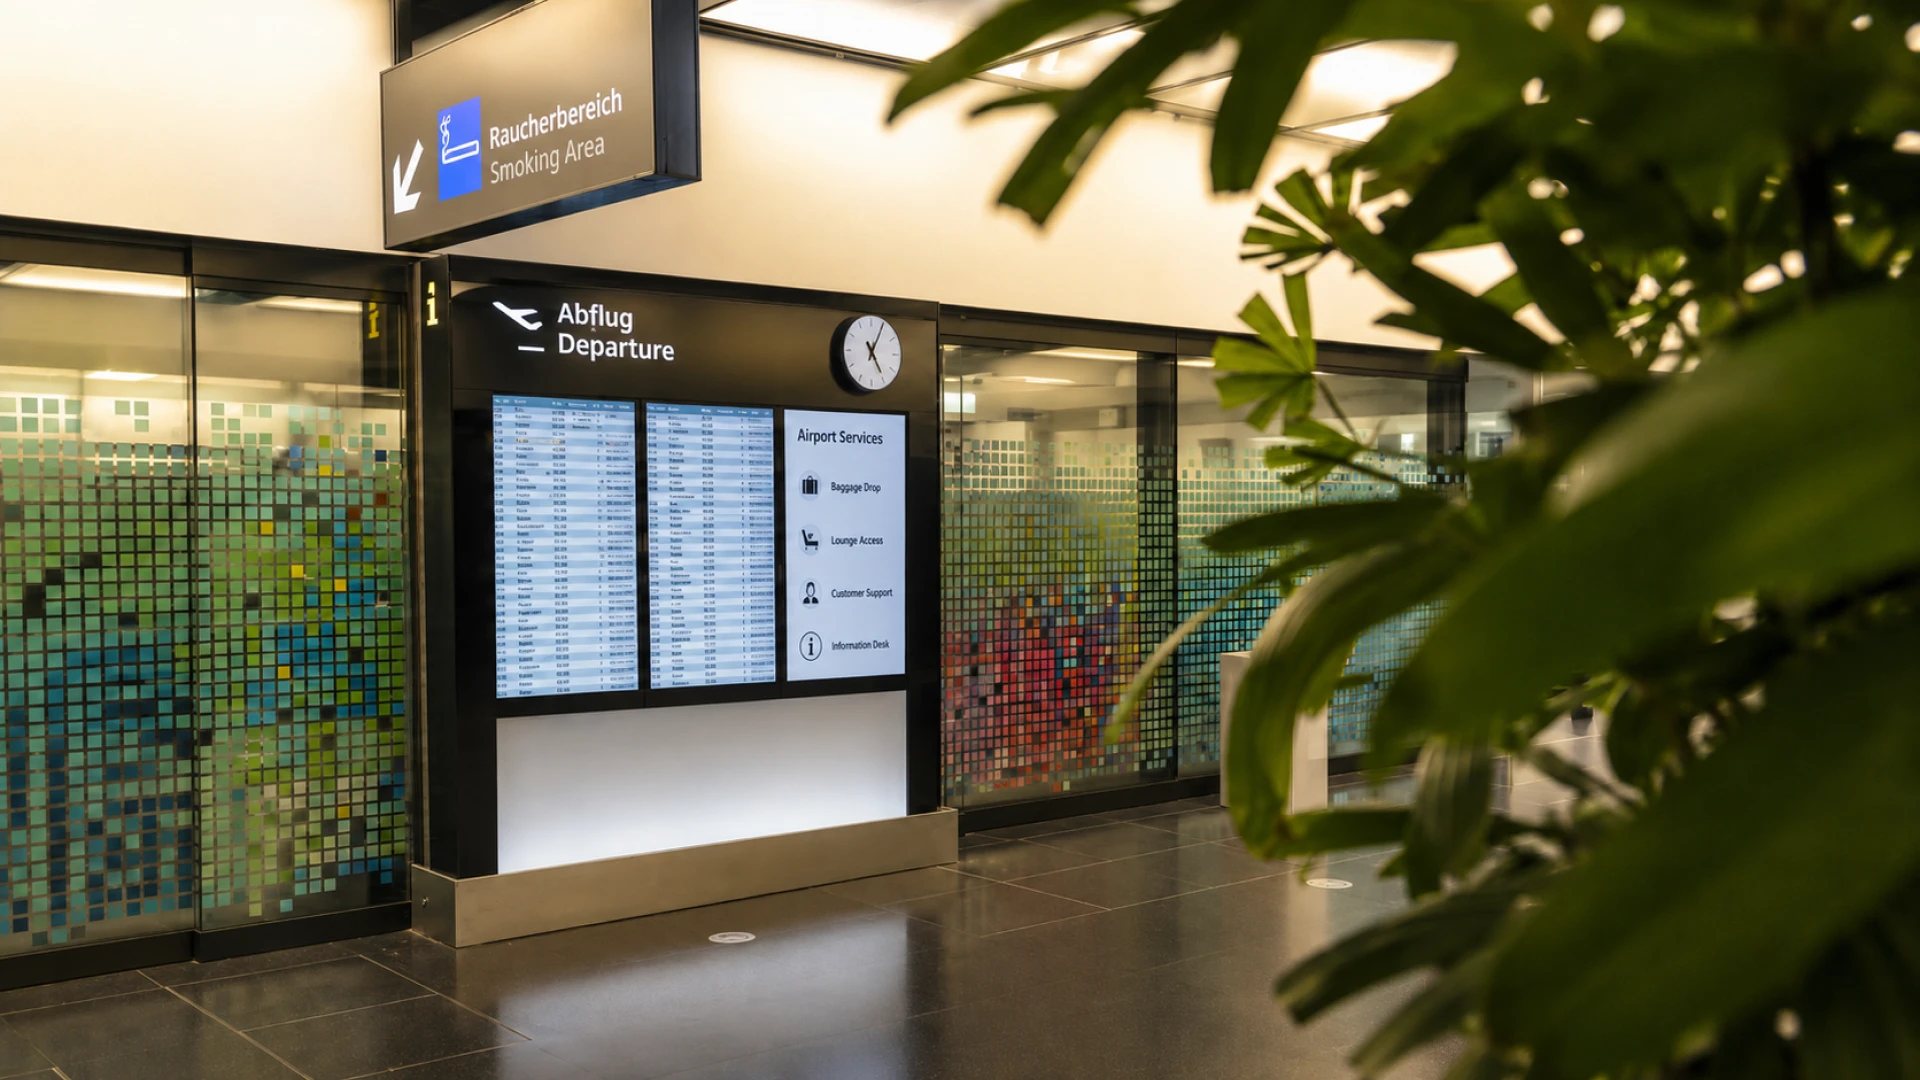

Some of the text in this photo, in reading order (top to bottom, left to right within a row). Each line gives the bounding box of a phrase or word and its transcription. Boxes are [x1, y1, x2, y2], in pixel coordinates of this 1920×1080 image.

[489, 87, 623, 150] Raucherbereich
[490, 136, 605, 184] Smoking Area
[557, 302, 633, 334] Abflug
[558, 332, 675, 362] Departure
[797, 428, 884, 446] Airport Services
[830, 481, 882, 494] Baggage Drop
[831, 535, 884, 547] Lounge Access
[831, 588, 893, 599] Customer Support
[831, 639, 890, 651] Information Desk
